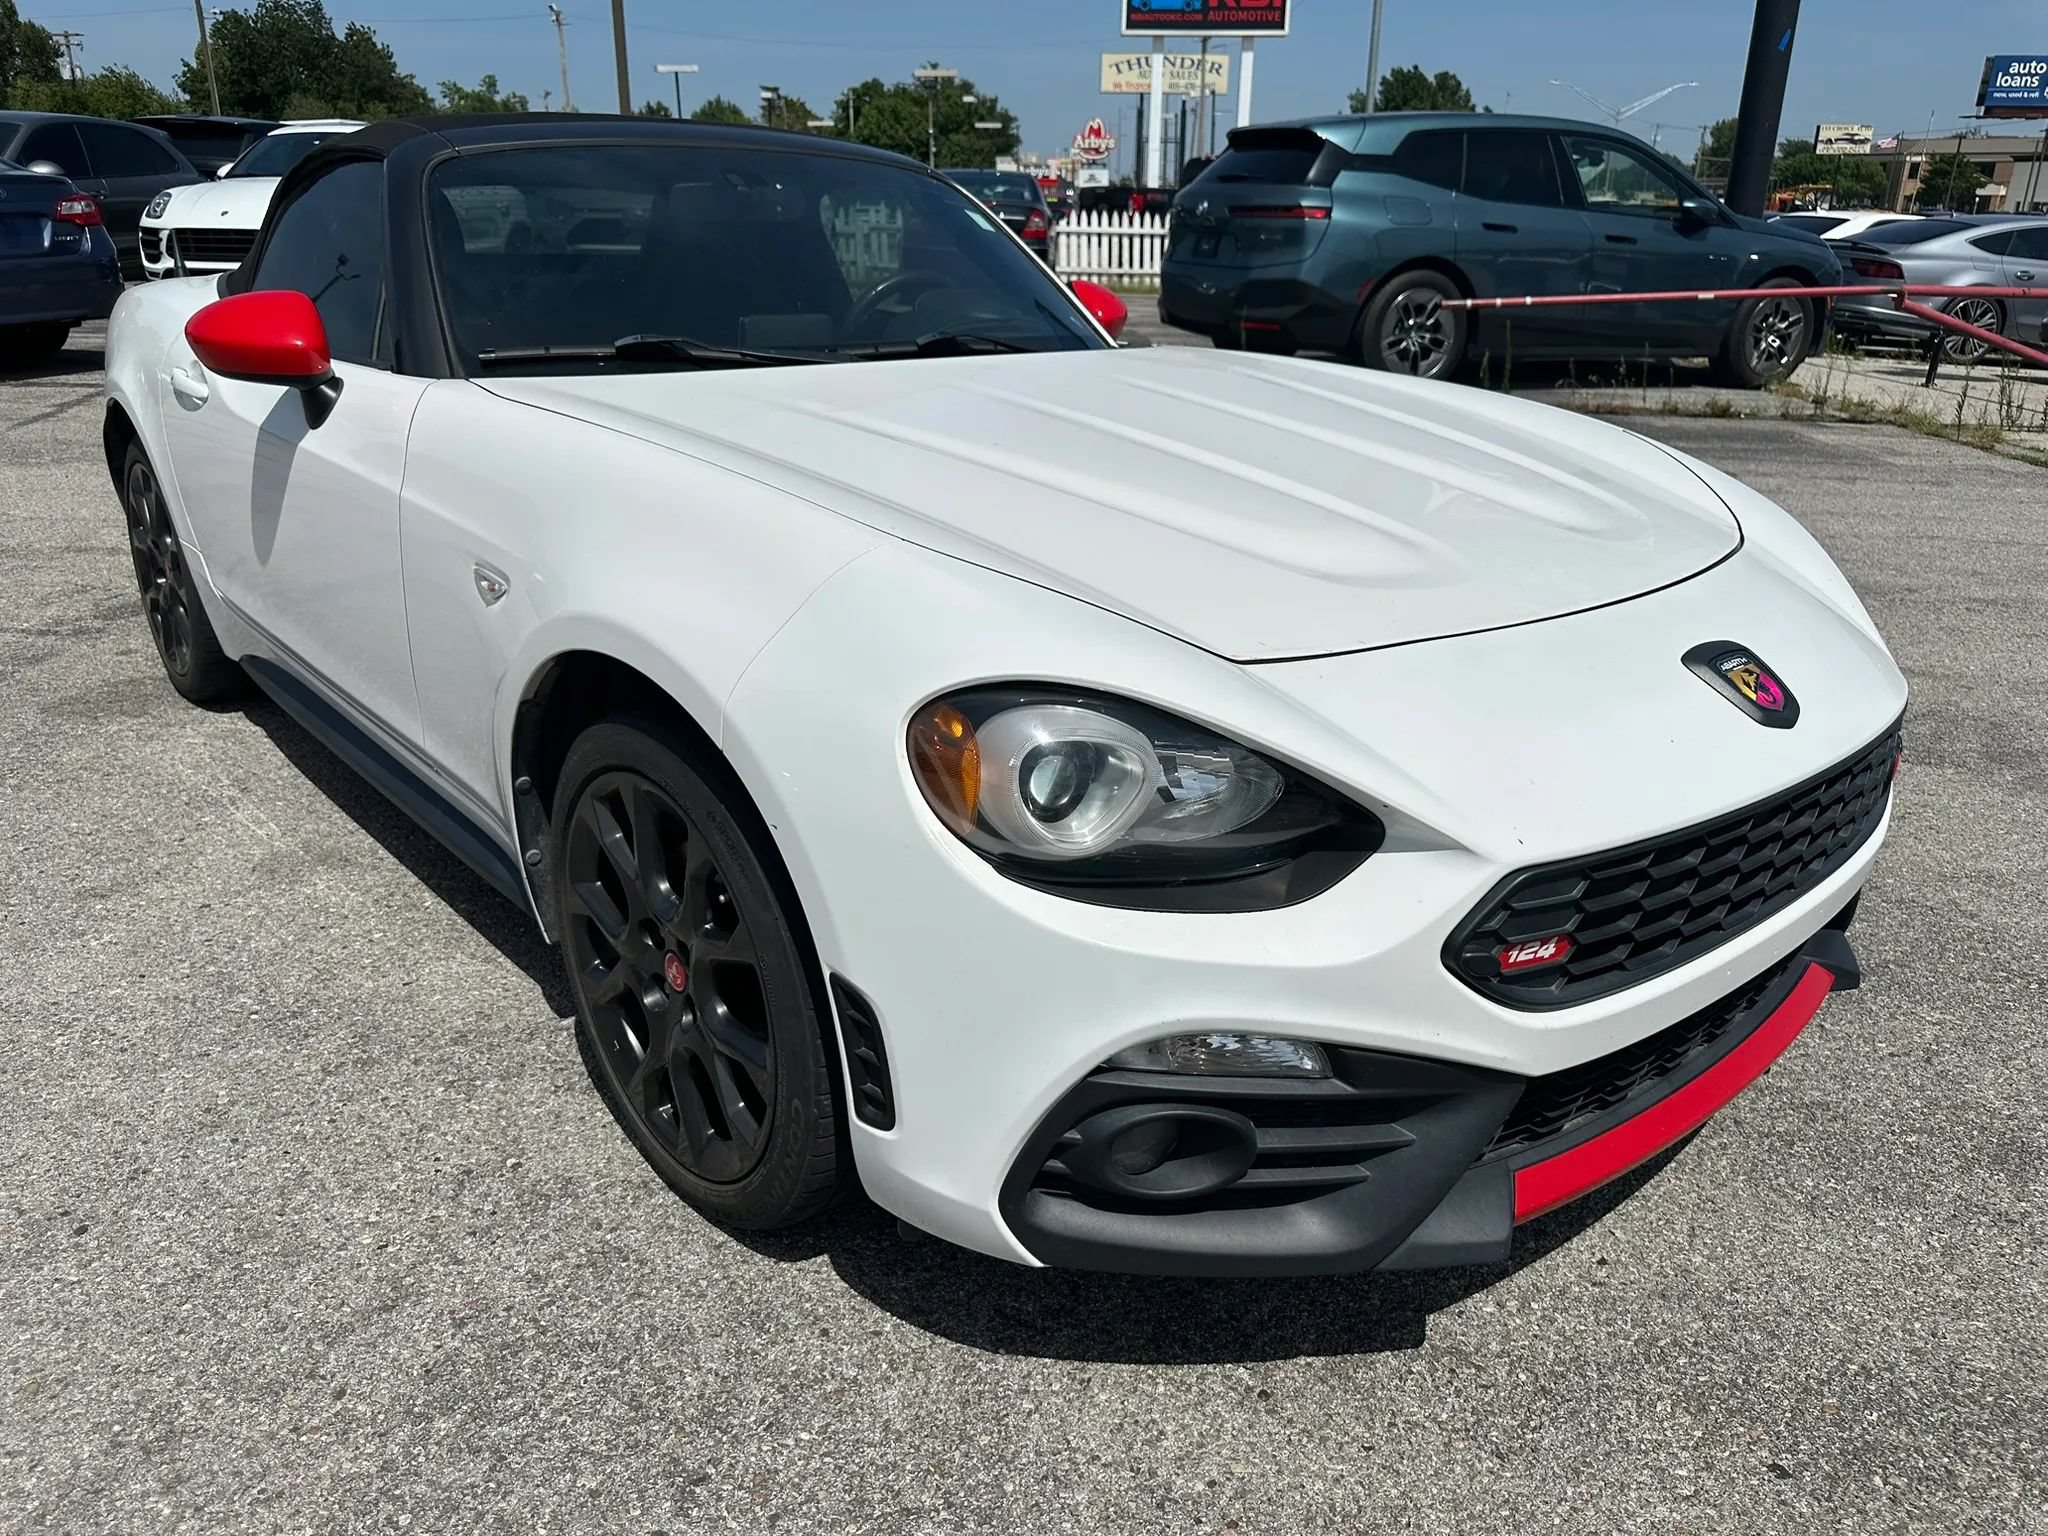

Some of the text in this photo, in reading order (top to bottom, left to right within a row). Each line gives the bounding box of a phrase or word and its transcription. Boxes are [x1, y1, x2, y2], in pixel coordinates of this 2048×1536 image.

[1208, 10, 1281, 21] AUTOMOTIVE
[2009, 60, 2047, 74] auto
[1169, 70, 1199, 80] SALES
[1996, 71, 2040, 87] loans
[1074, 135, 1115, 152] Arby's
[1720, 657, 1748, 671] ABARTH
[1508, 936, 1559, 964] 124
